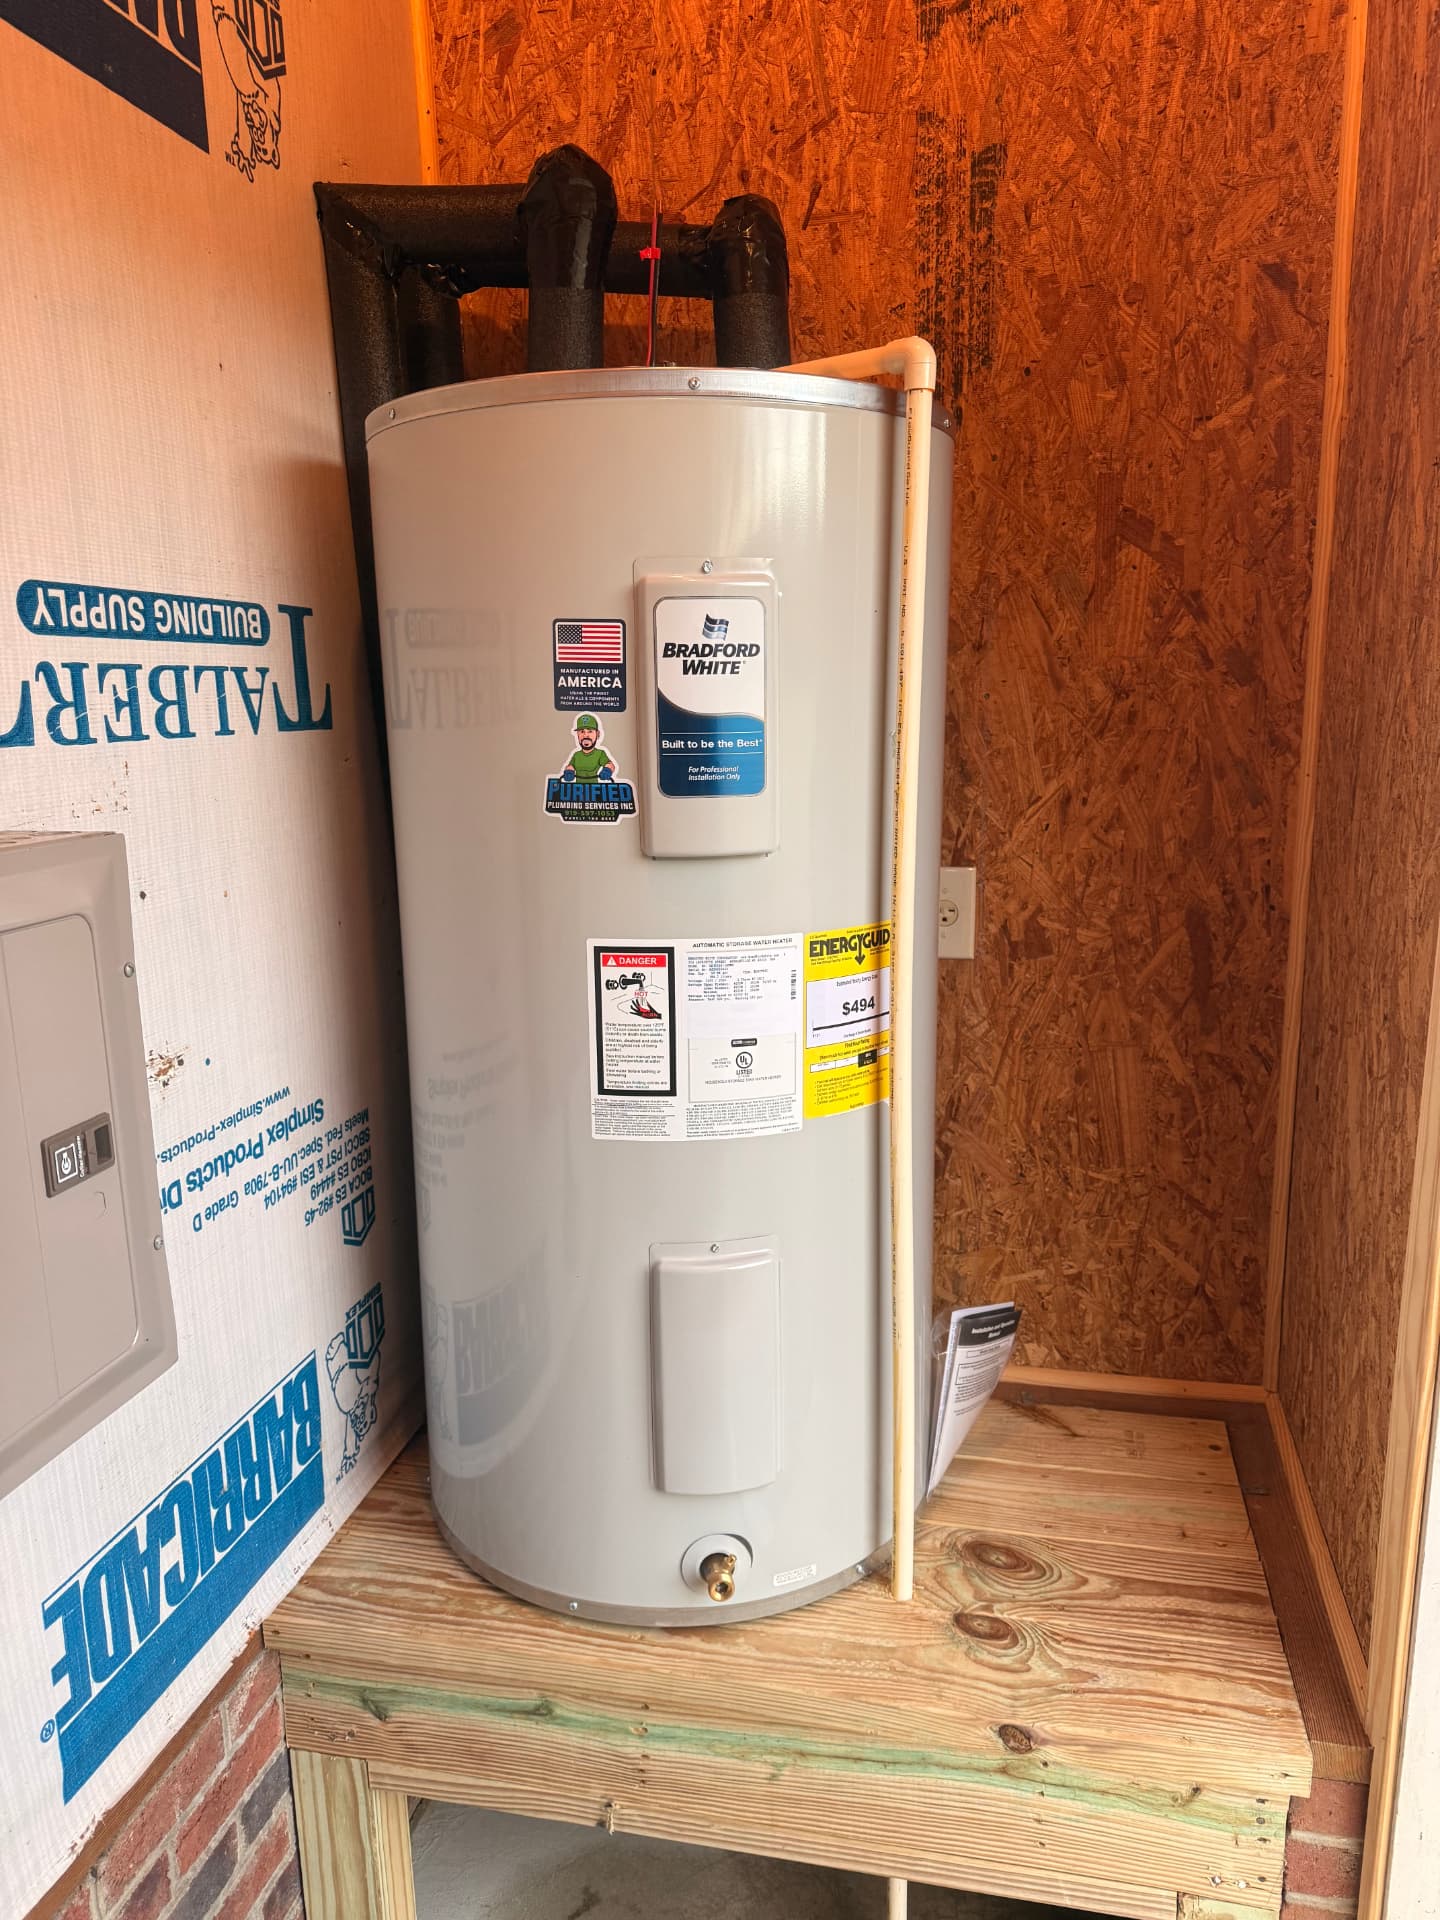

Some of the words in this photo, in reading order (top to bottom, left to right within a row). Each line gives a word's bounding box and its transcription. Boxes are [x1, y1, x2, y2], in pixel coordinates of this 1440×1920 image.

[33, 587, 144, 631] SUPPLY
[155, 599, 262, 639] BUILDING
[662, 643, 760, 658] BRADFORD
[682, 659, 741, 675] WHITE
[558, 676, 622, 688] AMERICA
[662, 740, 684, 748] Built
[701, 740, 714, 748] be
[737, 739, 759, 747] Best
[548, 780, 632, 802] PURIFIED
[810, 929, 890, 957] ENERGYGUID
[842, 996, 875, 1016] $494
[739, 1056, 748, 1065] UL
[266, 1099, 324, 1146] Simplex
[344, 1108, 369, 1129] Meets
[324, 1124, 342, 1143] Fed.
[344, 1127, 370, 1148] SBCCI
[186, 1133, 263, 1193] Products
[317, 1157, 323, 1173] &
[326, 1145, 342, 1167] PST
[351, 1146, 371, 1168] ICBO
[300, 1163, 314, 1185] ESI
[337, 1162, 348, 1178] ES
[348, 1166, 373, 1186] BOCA
[159, 1178, 182, 1215] Di
[264, 1176, 297, 1210] #94104
[310, 1172, 335, 1200] #4449
[335, 1184, 346, 1201] ES
[204, 1190, 239, 1221] Grade
[304, 1194, 334, 1227] #92-45
[193, 1212, 202, 1233] D
[345, 1282, 381, 1323] SIMPLEX
[42, 1362, 323, 1718] BARRICADE
